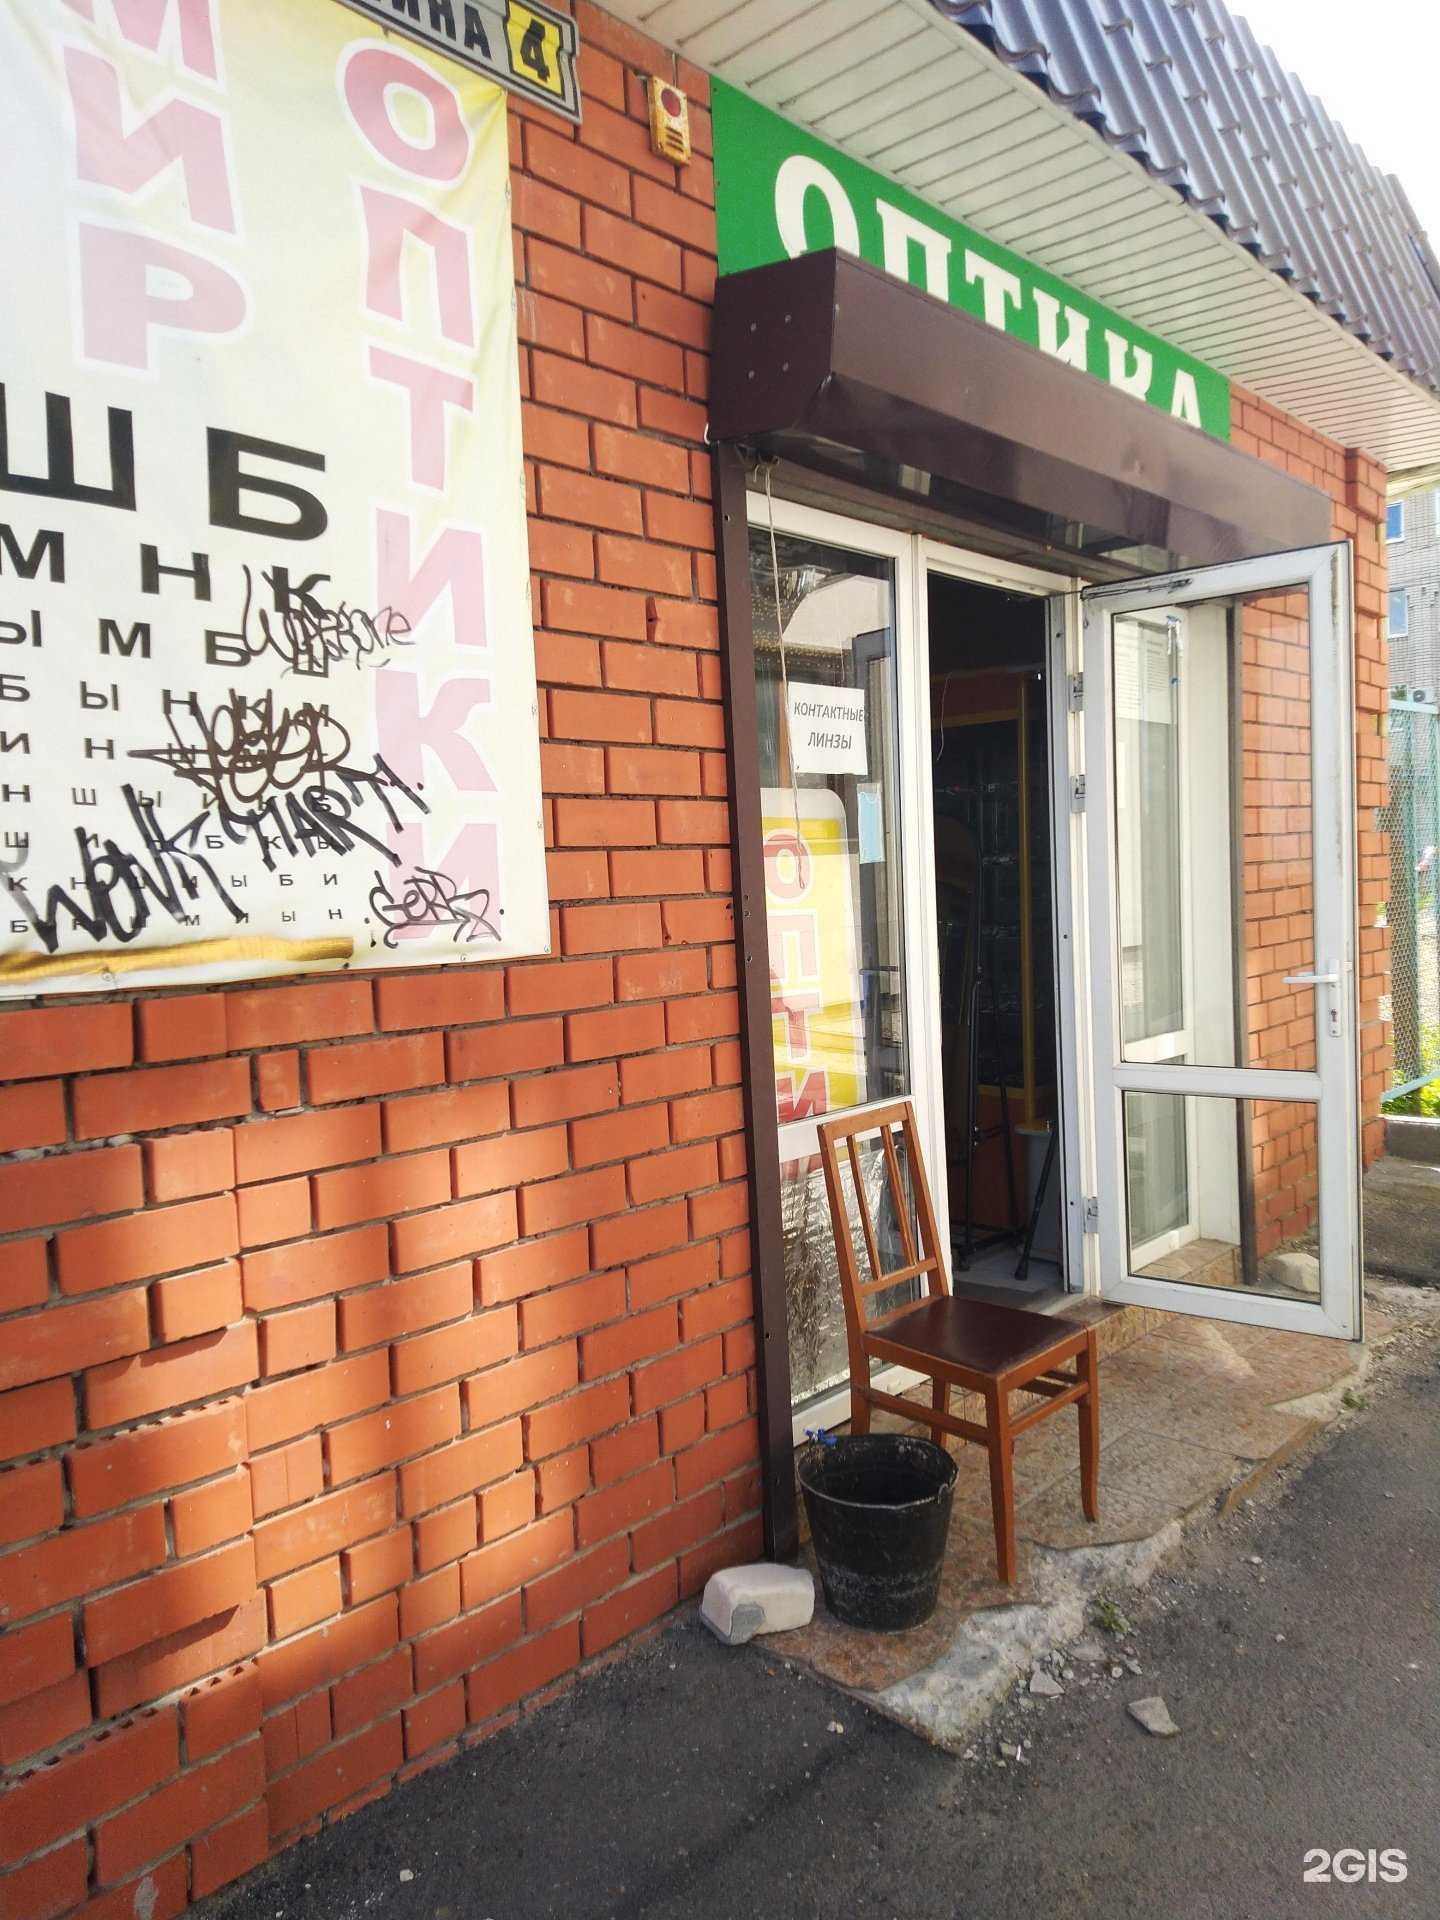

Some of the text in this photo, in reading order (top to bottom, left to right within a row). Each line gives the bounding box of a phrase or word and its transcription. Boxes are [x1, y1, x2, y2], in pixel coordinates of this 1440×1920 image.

[520, 17, 551, 83] 4
[0, 382, 329, 541] Ш Б
[343, 48, 501, 943] ОПТИКИ
[0, 522, 66, 583] М
[140, 543, 212, 602] Н
[99, 618, 152, 659] М
[205, 629, 251, 667] Б
[0, 673, 31, 702] Б
[80, 681, 120, 711] Ы
[793, 701, 864, 723] КОНТАКТНЫЕ
[0, 731, 31, 754] И
[84, 738, 115, 760] Н
[807, 731, 852, 750] ЛИНЗЫ
[2, 784, 31, 802] Н
[72, 787, 97, 806] Ш
[205, 835, 225, 849] Б
[280, 874, 295, 887] Б
[324, 873, 339, 886] И
[762, 830, 828, 1175] ОПТИ
